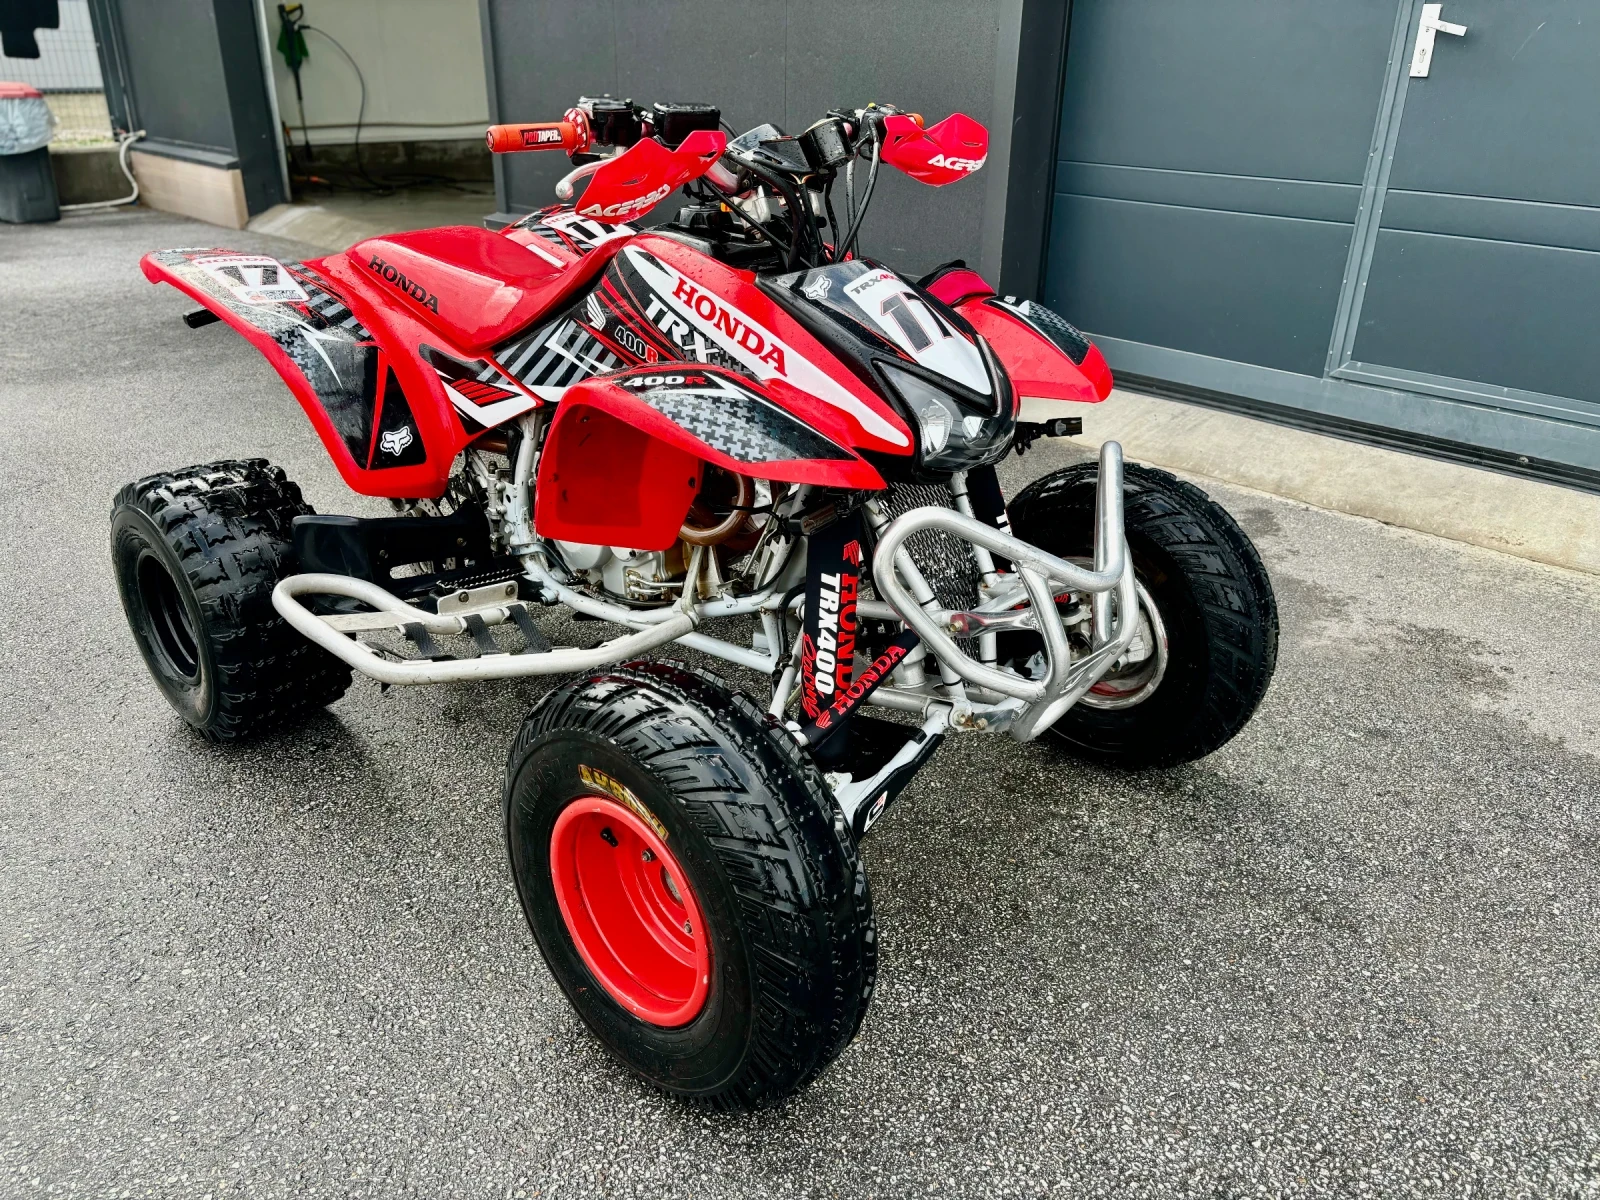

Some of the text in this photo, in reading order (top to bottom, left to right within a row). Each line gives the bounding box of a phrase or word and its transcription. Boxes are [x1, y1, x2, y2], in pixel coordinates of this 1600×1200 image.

[565, 218, 617, 240] 17
[214, 264, 280, 287] 17
[368, 253, 440, 315] HONDA
[614, 325, 659, 364] 400R
[644, 293, 720, 363] TRX
[671, 275, 788, 378] HONDA
[623, 375, 707, 387] 400R
[814, 572, 841, 696] TRX400
[834, 572, 859, 702] HOND
[833, 644, 907, 716] HONDA
